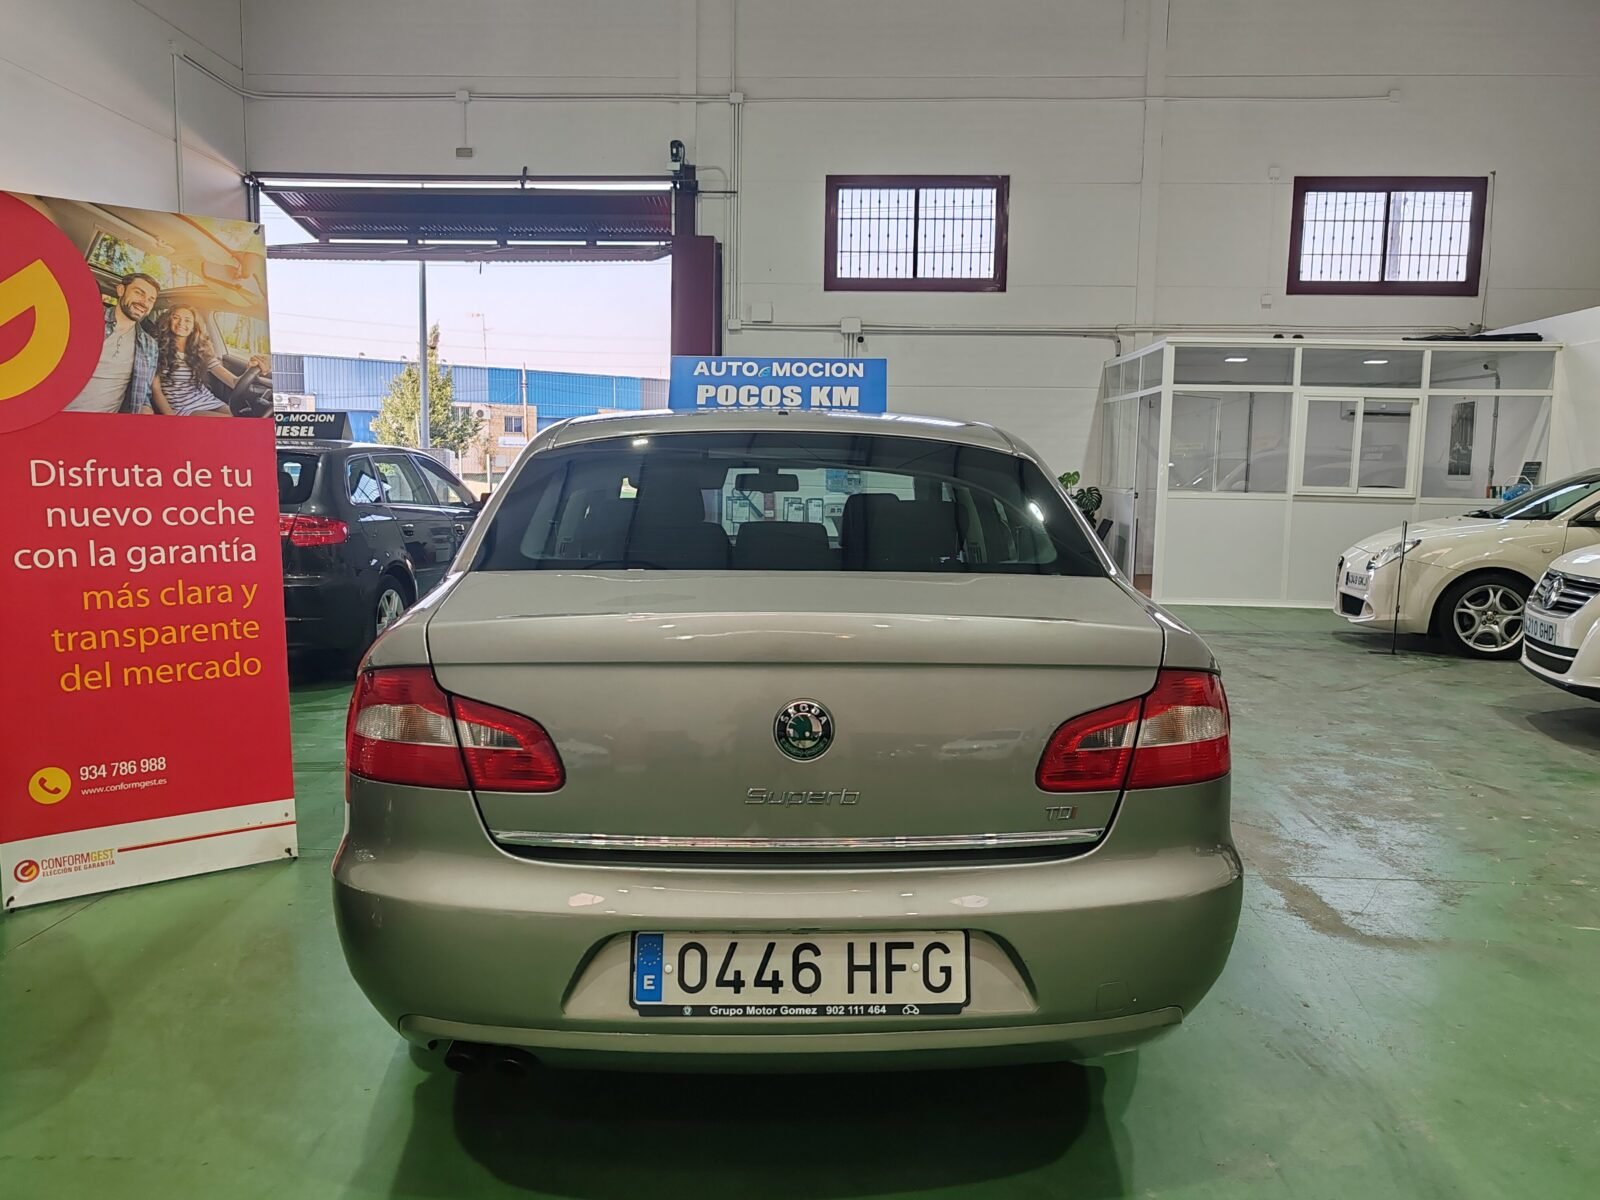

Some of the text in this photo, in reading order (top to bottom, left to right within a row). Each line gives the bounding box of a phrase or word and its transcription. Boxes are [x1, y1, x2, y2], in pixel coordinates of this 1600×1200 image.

[696, 385, 860, 407] POCOS KM
[275, 425, 315, 437] IESEL
[30, 459, 252, 488] Disfruta de tu
[46, 499, 255, 528] nuevo coche
[13, 537, 257, 573] con la garantía
[82, 579, 258, 611] más clara y
[51, 618, 260, 653] transparente
[59, 652, 262, 692] del mercado
[80, 756, 167, 781] 934 786 988
[81, 778, 167, 796] www.conformgest.es
[744, 787, 860, 808] Superb
[41, 848, 115, 871] CONFORMGEST
[74, 864, 82, 872] DE
[677, 941, 952, 995] 0446 HFG
[643, 975, 656, 990] E
[709, 1004, 887, 1017] Grupo Motor Gomez 902 111 464
